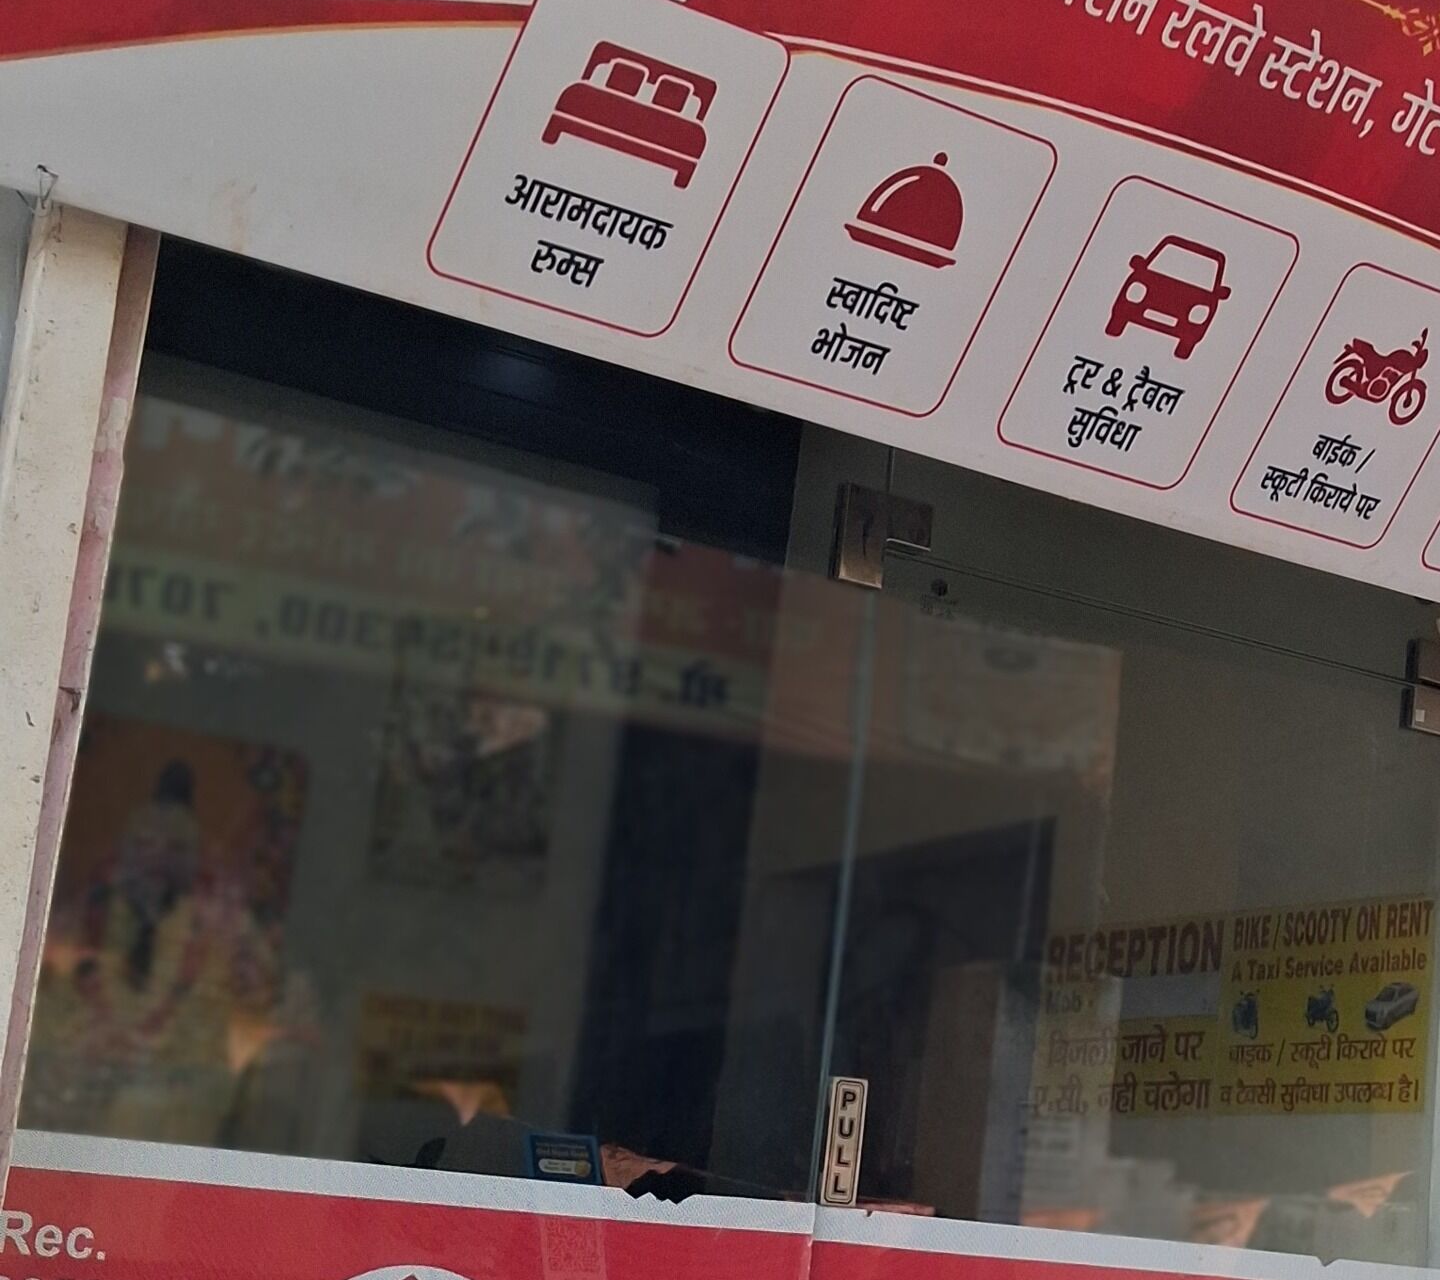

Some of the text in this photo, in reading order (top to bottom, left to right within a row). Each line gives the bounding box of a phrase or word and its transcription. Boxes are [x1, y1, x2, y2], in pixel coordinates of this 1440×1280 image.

[1259, 29, 1382, 139] स्टेशन,
[505, 173, 674, 251] आरामदायक
[530, 239, 604, 288] रुम्स
[811, 322, 891, 376] भोजन
[1062, 355, 1104, 395] टूर
[1101, 367, 1123, 398] &
[1067, 405, 1142, 452] सुविधा
[1312, 434, 1376, 474] बाईक /
[1260, 465, 1381, 520] स्कूटी किराये पर
[1233, 901, 1435, 951] BIKE / SCOOTY ON RENT
[1045, 920, 1225, 983] RECEPTION
[1248, 959, 1281, 981] Taxi
[1285, 955, 1343, 979] Service
[1349, 948, 1428, 975] Available
[1121, 1023, 1167, 1063] जाने
[1174, 1031, 1206, 1061] पर
[1276, 1038, 1285, 1067] /
[1290, 1035, 1331, 1069] स्कूटी
[1336, 1033, 1387, 1062] किराये
[1391, 1037, 1417, 1060] पर
[1143, 1070, 1212, 1111] चलेगा
[1280, 1076, 1329, 1112] सुविधा
[1334, 1080, 1394, 1105] उपलब्ध
[832, 1091, 856, 1195] PULL
[0, 1209, 107, 1261] Rec.
